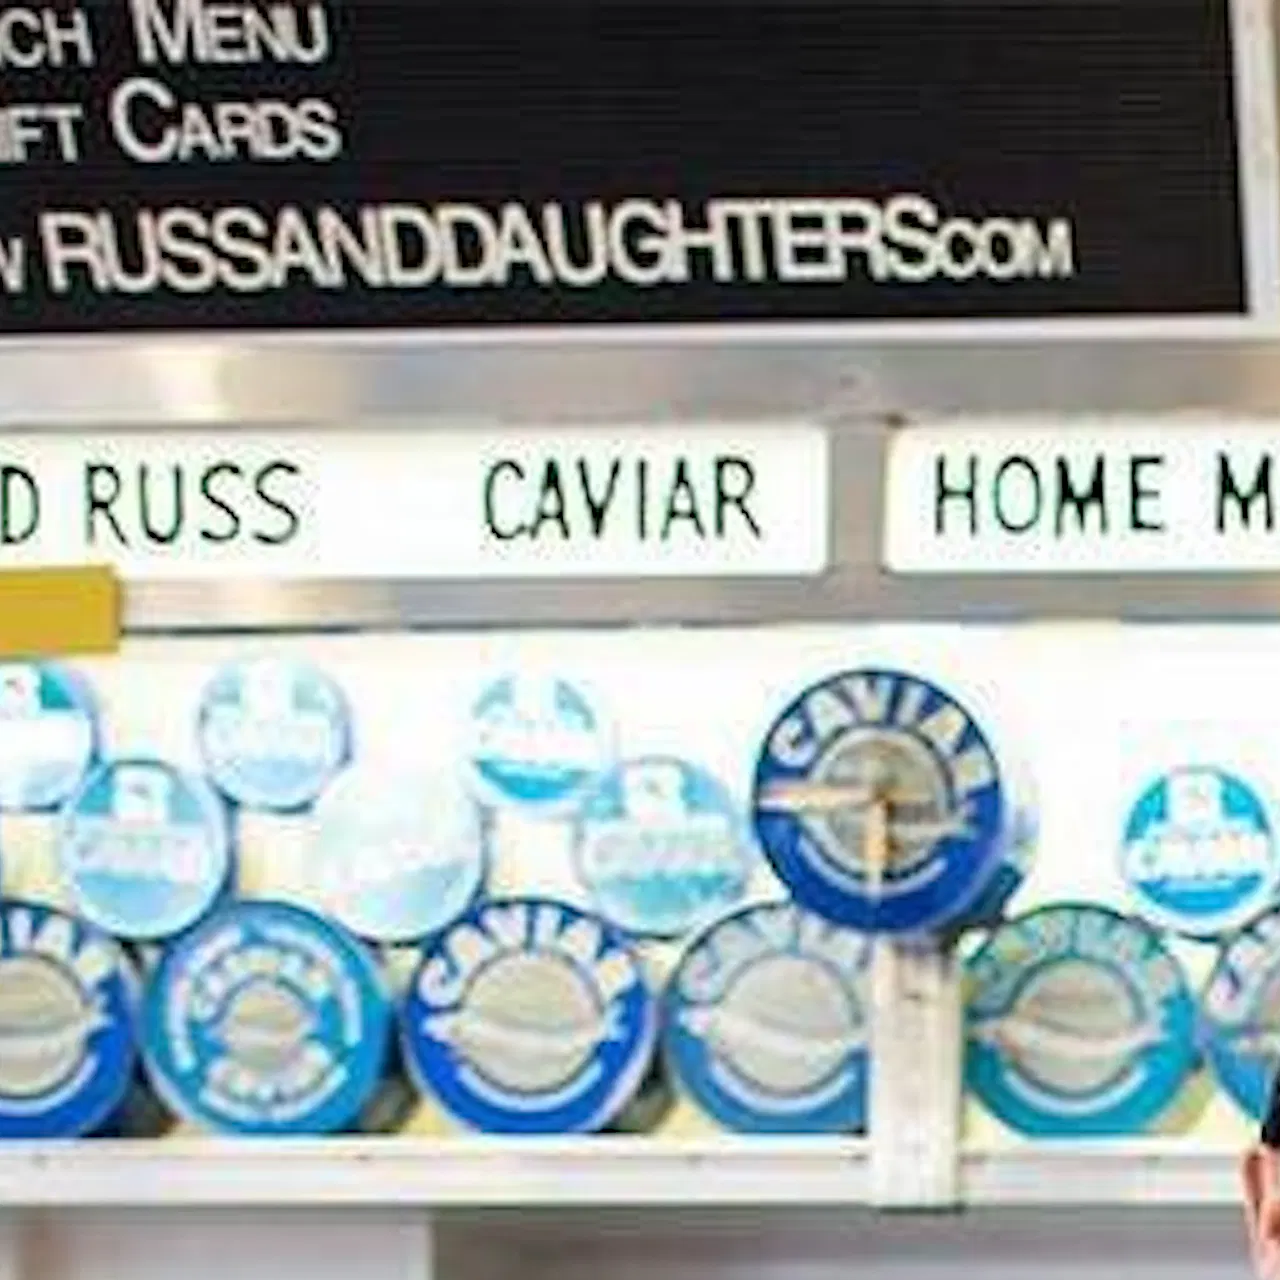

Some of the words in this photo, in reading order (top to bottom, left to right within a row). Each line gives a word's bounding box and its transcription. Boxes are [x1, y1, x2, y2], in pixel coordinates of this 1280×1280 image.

[130, 0, 330, 64] MENU
[109, 77, 344, 162] CARDS
[85, 461, 302, 547] RUSS
[483, 457, 763, 541] CAVIAR
[935, 451, 1167, 537] HOME
[767, 675, 997, 798] CAVIAR
[419, 902, 638, 1008] CAVIAR
